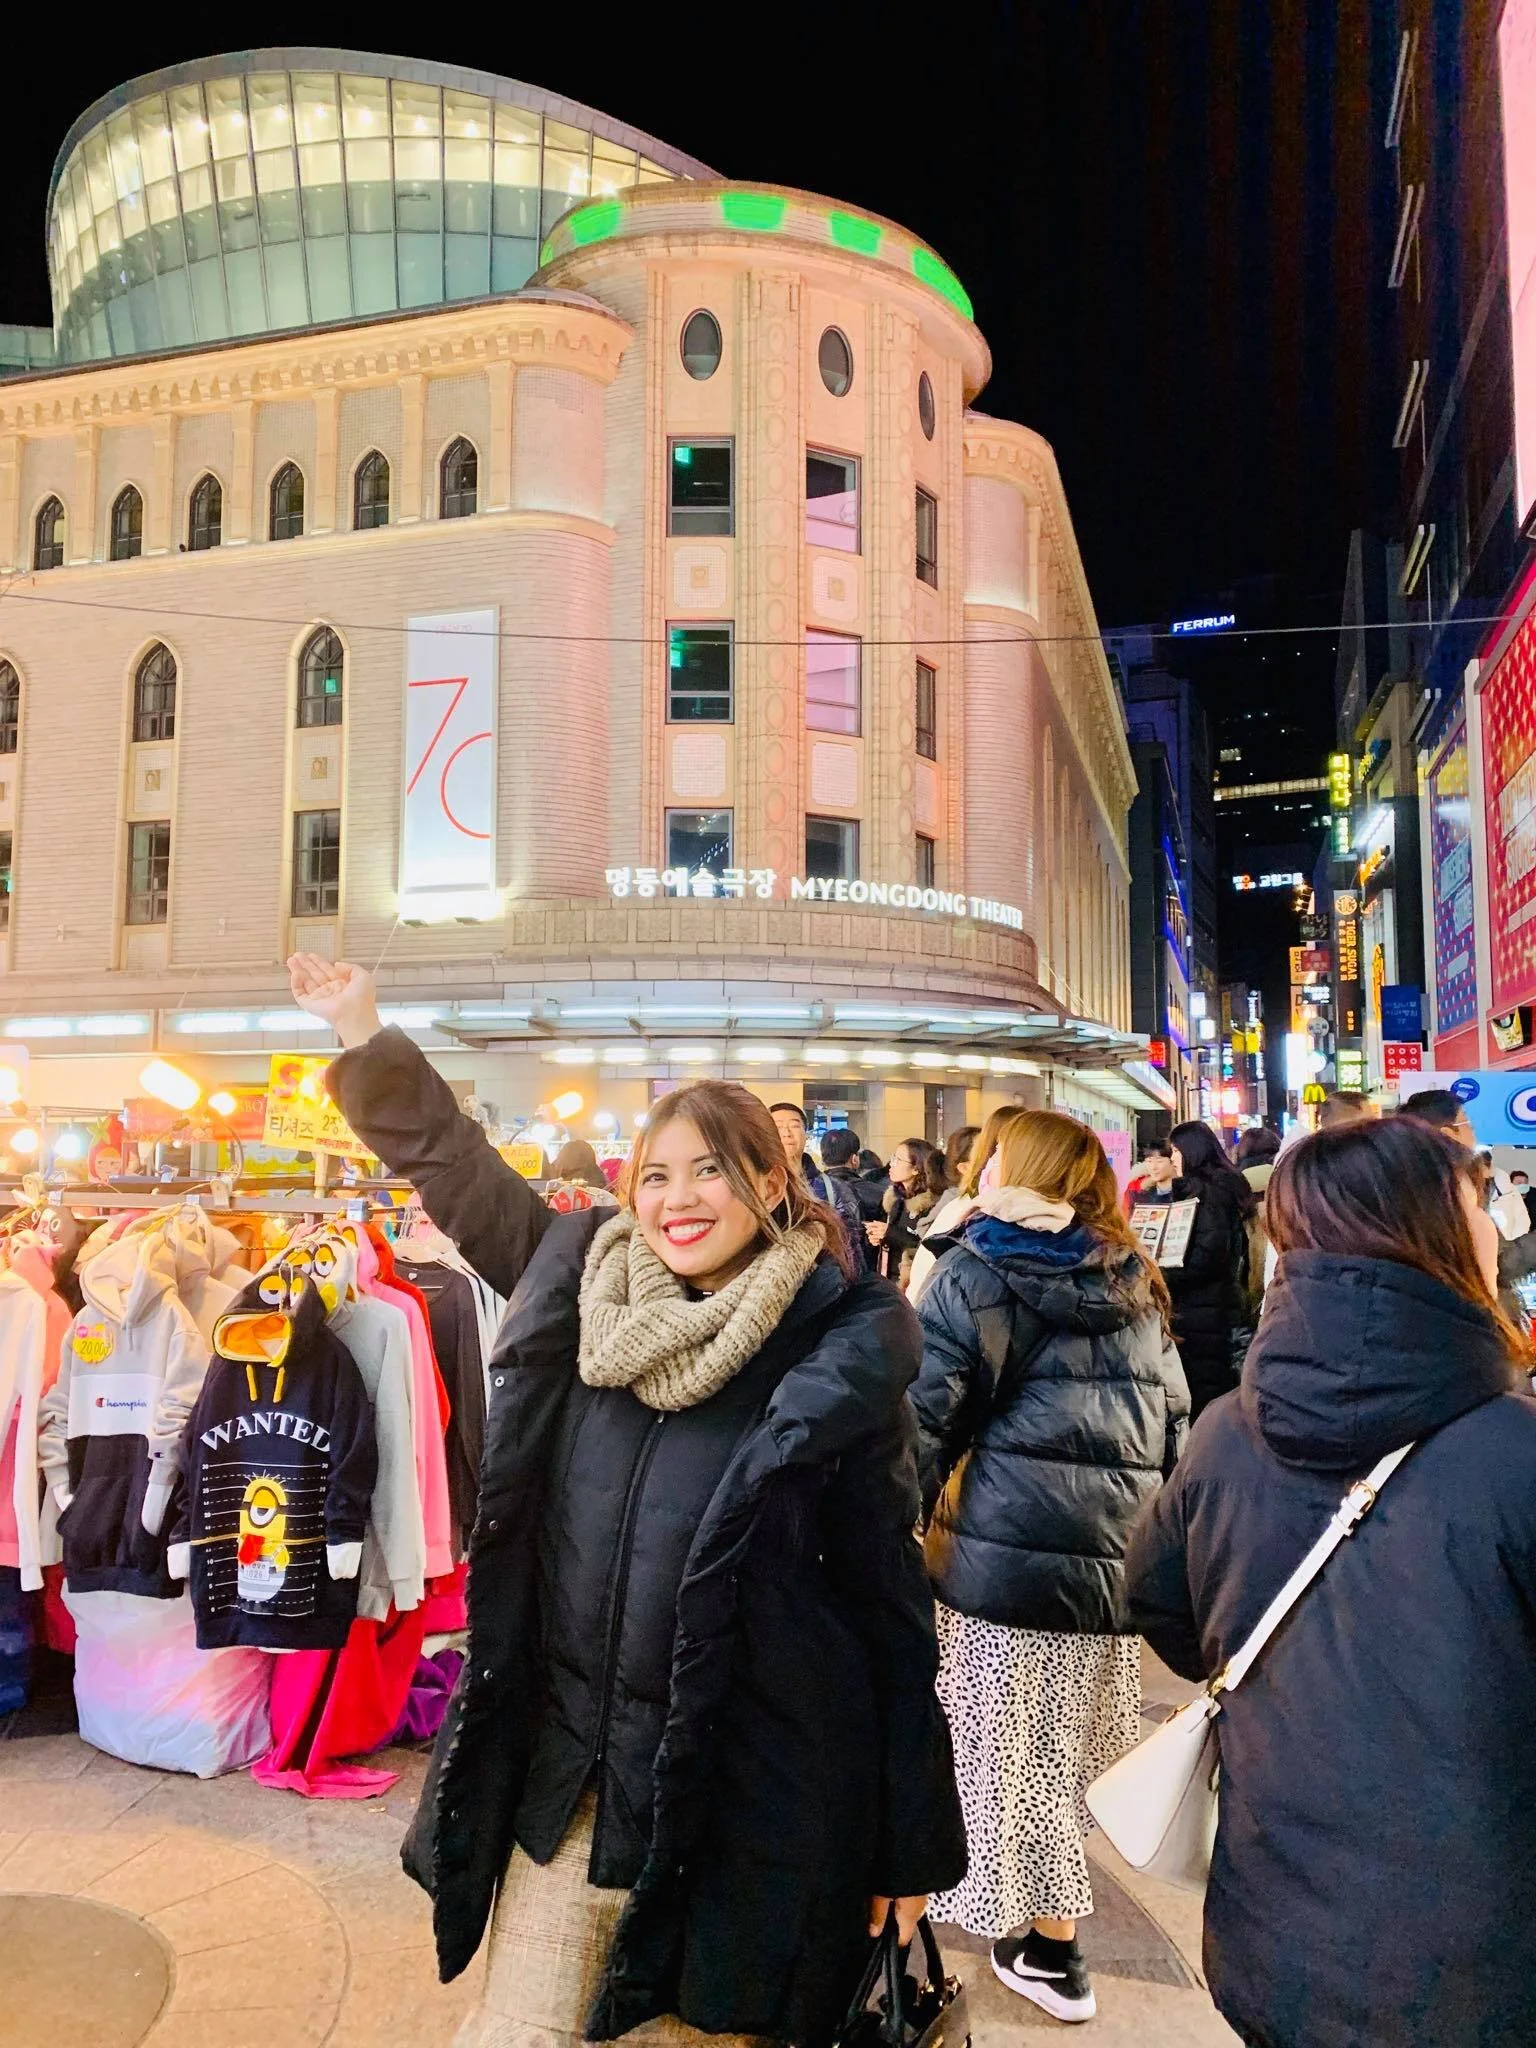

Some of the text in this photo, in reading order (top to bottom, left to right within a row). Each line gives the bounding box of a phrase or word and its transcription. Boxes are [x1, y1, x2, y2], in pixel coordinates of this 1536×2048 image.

[1173, 614, 1235, 632] FERRUM
[605, 867, 777, 898] 명동예술극장
[791, 876, 966, 917] MYEONGDONG
[1346, 919, 1358, 981] TIGER SUGAR
[200, 1411, 330, 1452] WANTED
